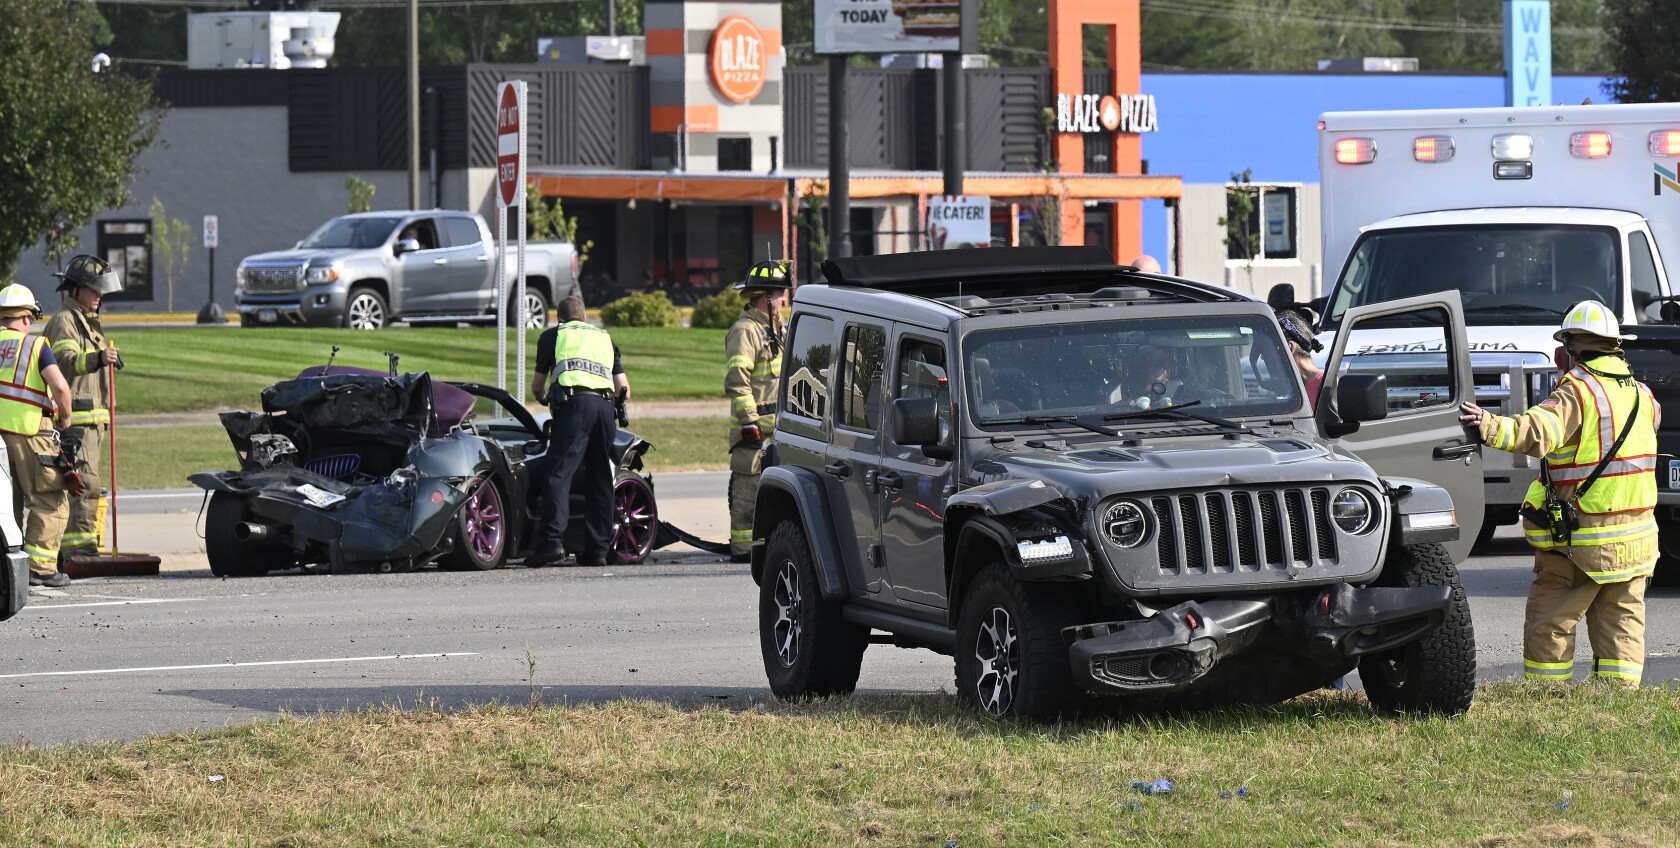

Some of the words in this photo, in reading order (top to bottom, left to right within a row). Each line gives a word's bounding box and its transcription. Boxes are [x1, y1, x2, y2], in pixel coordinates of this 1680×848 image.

[840, 10, 888, 23] TODAY
[721, 34, 760, 71] BLAZE
[724, 72, 759, 82] PIZZA
[500, 108, 507, 127] DO
[508, 106, 518, 126] NOT
[1057, 92, 1101, 132] BLAZE
[1120, 93, 1158, 132] PIZZA
[501, 162, 515, 182] ENTER
[943, 206, 984, 220] CATER!
[567, 361, 605, 376] POLICE
